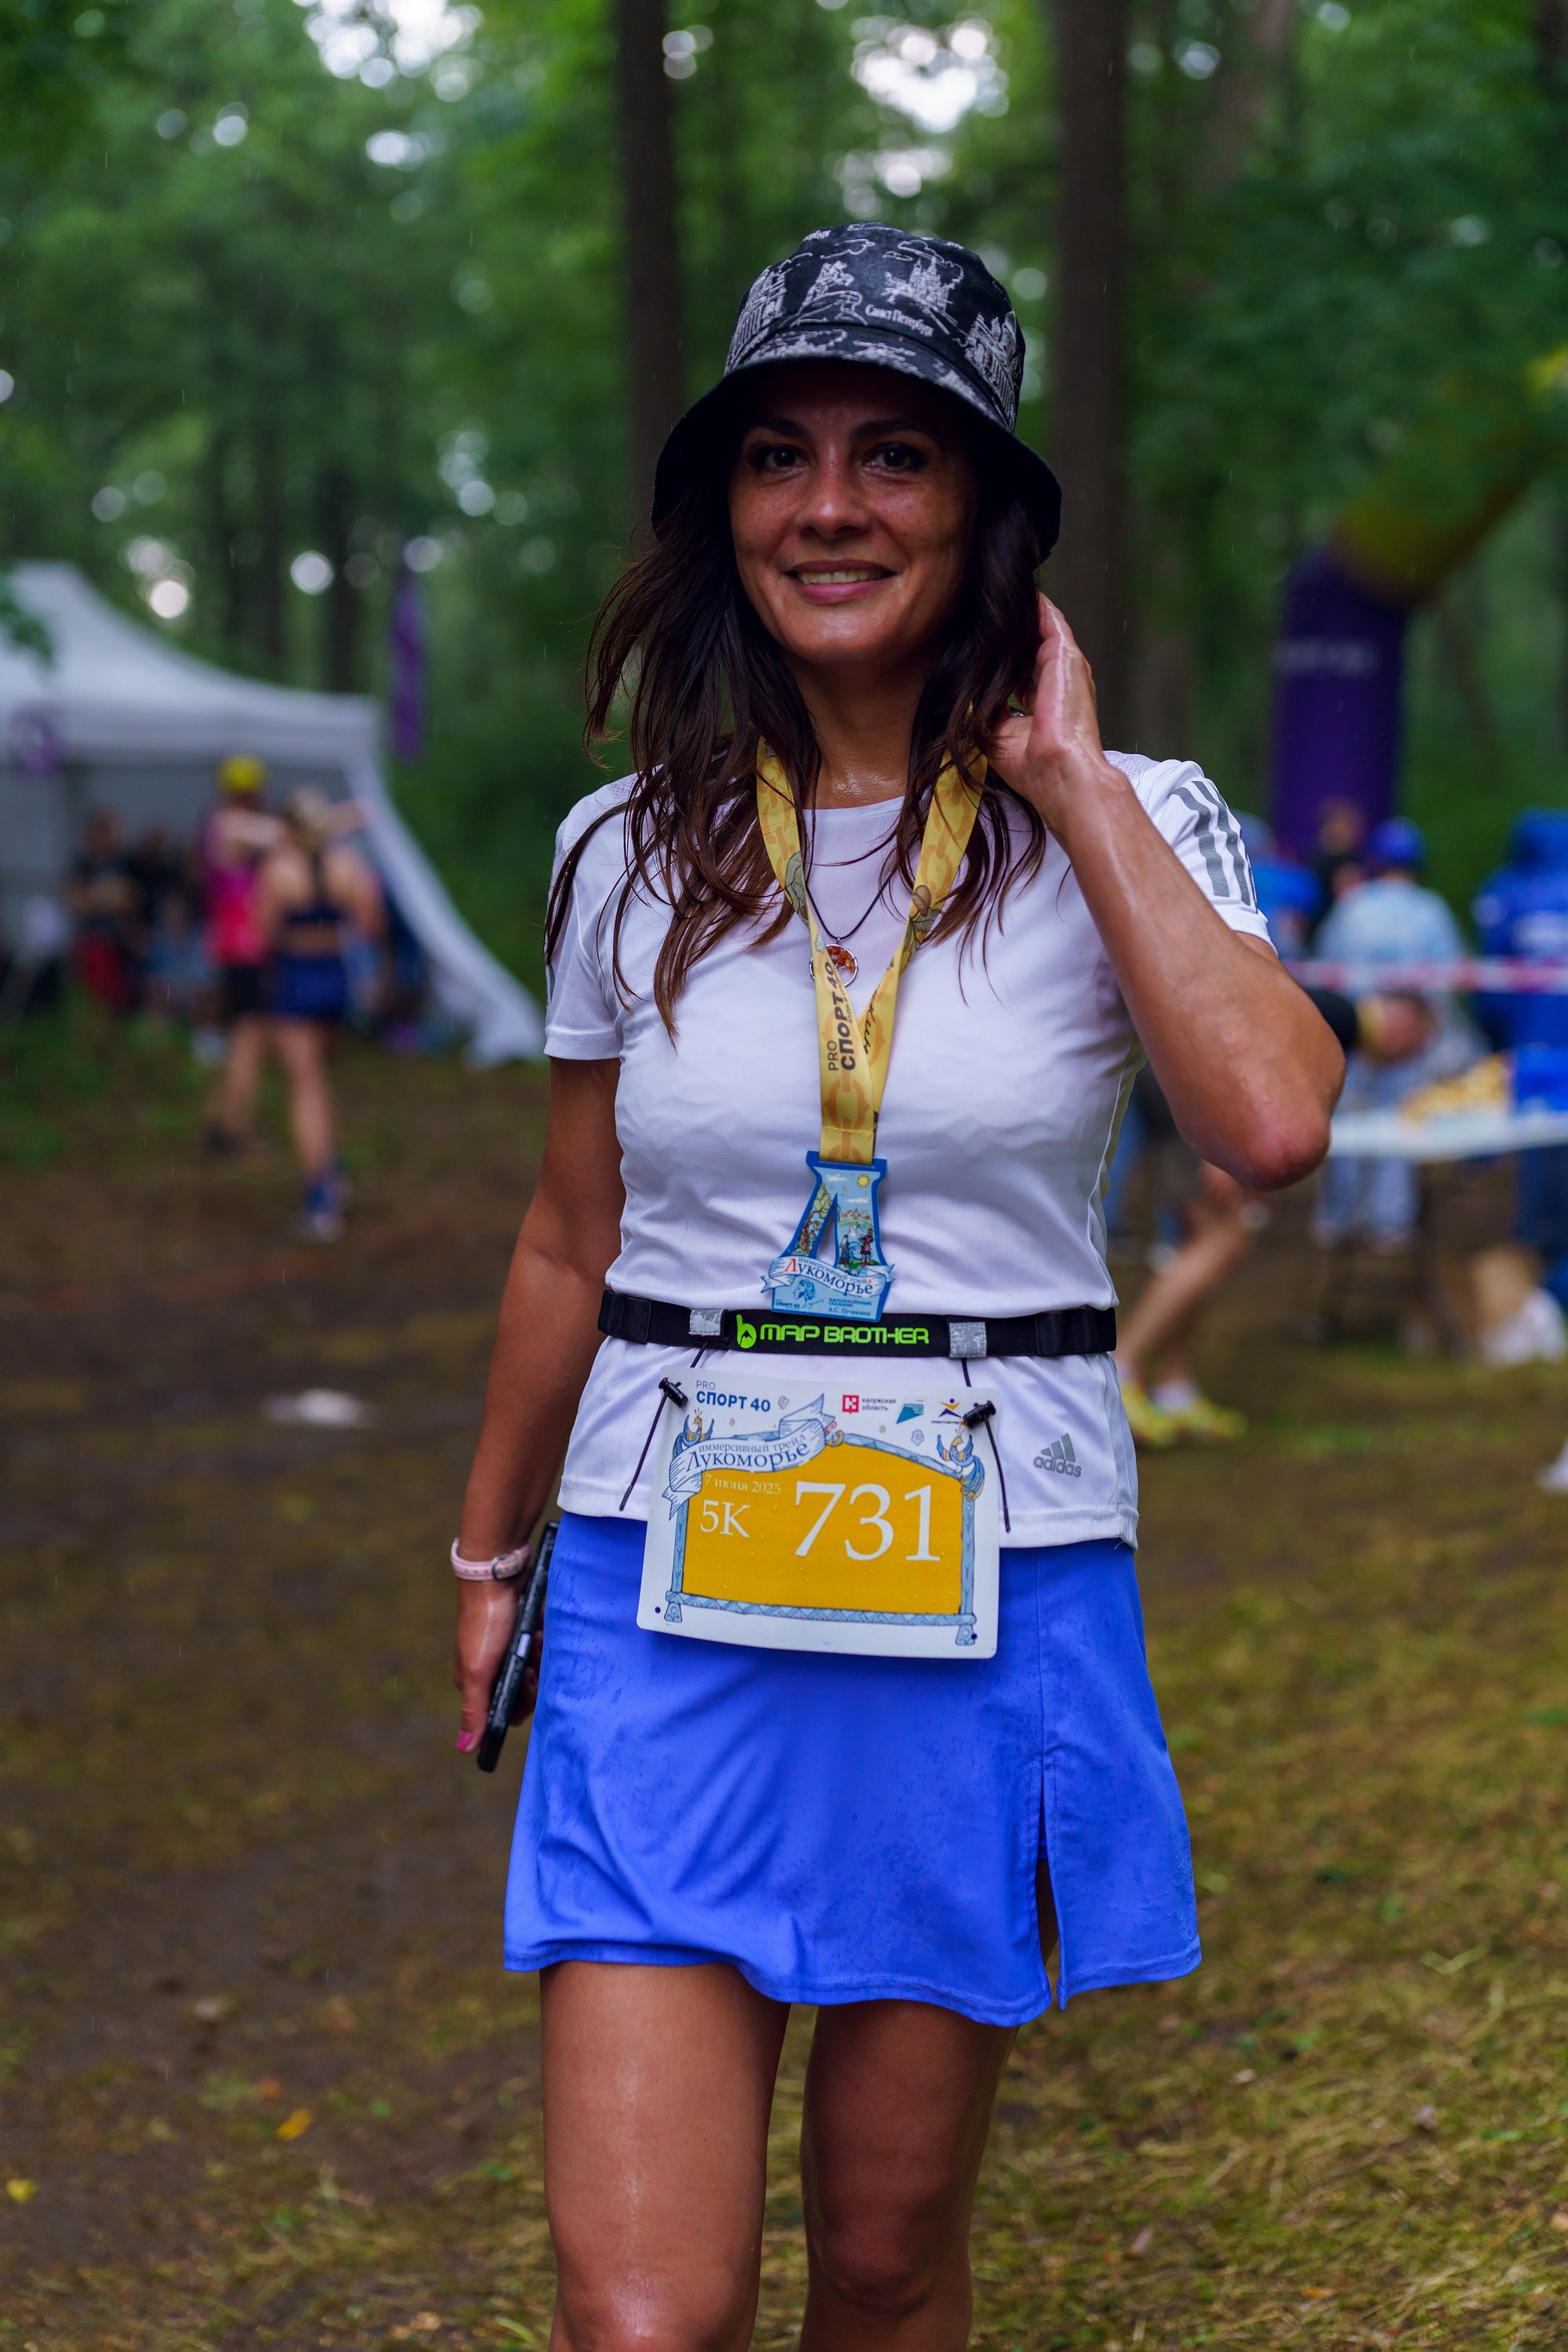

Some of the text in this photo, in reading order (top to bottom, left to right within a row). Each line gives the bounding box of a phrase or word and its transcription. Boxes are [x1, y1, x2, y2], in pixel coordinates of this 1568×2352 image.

[825, 961, 838, 989] 40
[831, 991, 856, 1071] СПОРТ
[827, 1040, 839, 1071] PRO
[784, 1258, 873, 1295] Лукоморье
[760, 1323, 820, 1341] MAP
[823, 1326, 929, 1345] BROTHER
[696, 1380, 716, 1391] PRO
[696, 1391, 771, 1412] СПОРТ 40
[699, 1434, 806, 1454] иммерсивный трейл
[686, 1443, 810, 1472] Лукоморье
[1033, 1454, 1082, 1478] adidas
[706, 1475, 781, 1494] 7 июня 2025
[795, 1480, 941, 1562] 731
